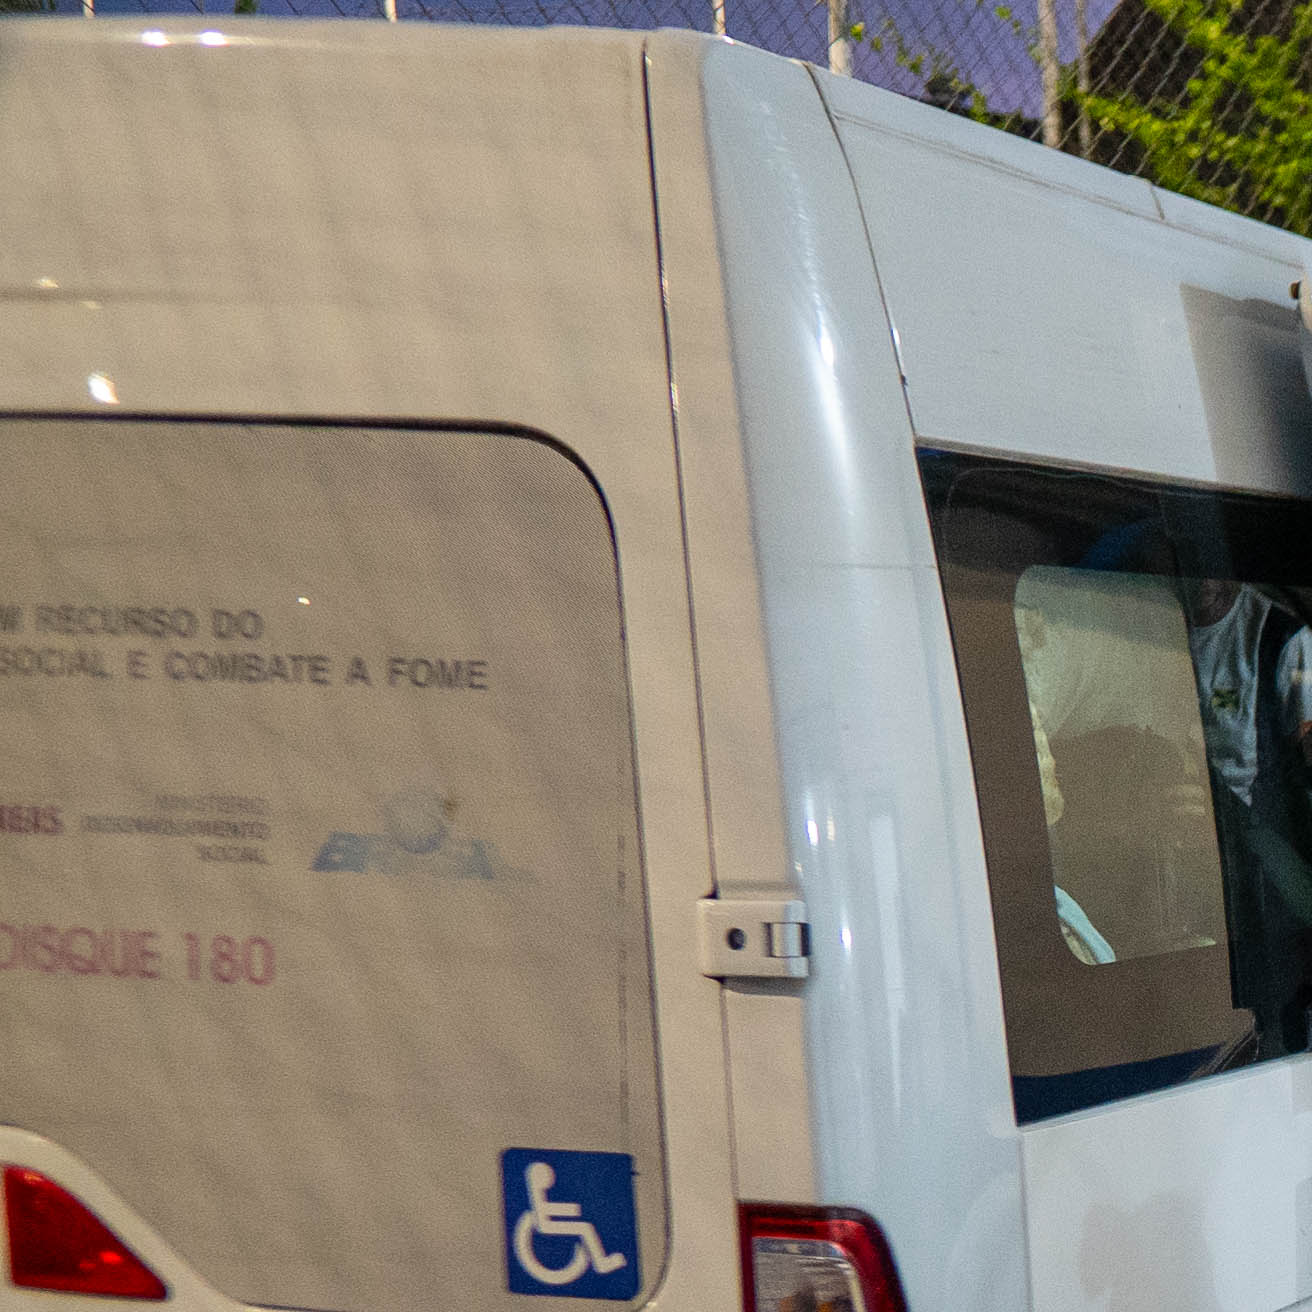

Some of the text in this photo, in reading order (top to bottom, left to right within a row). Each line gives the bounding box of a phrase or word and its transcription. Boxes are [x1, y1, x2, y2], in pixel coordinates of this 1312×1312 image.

[36, 604, 199, 639] RECURSO
[211, 608, 264, 640] DO
[0, 648, 489, 691] SOCIAL E COMBATE A FOME
[0, 922, 276, 985] DISQUE 180
